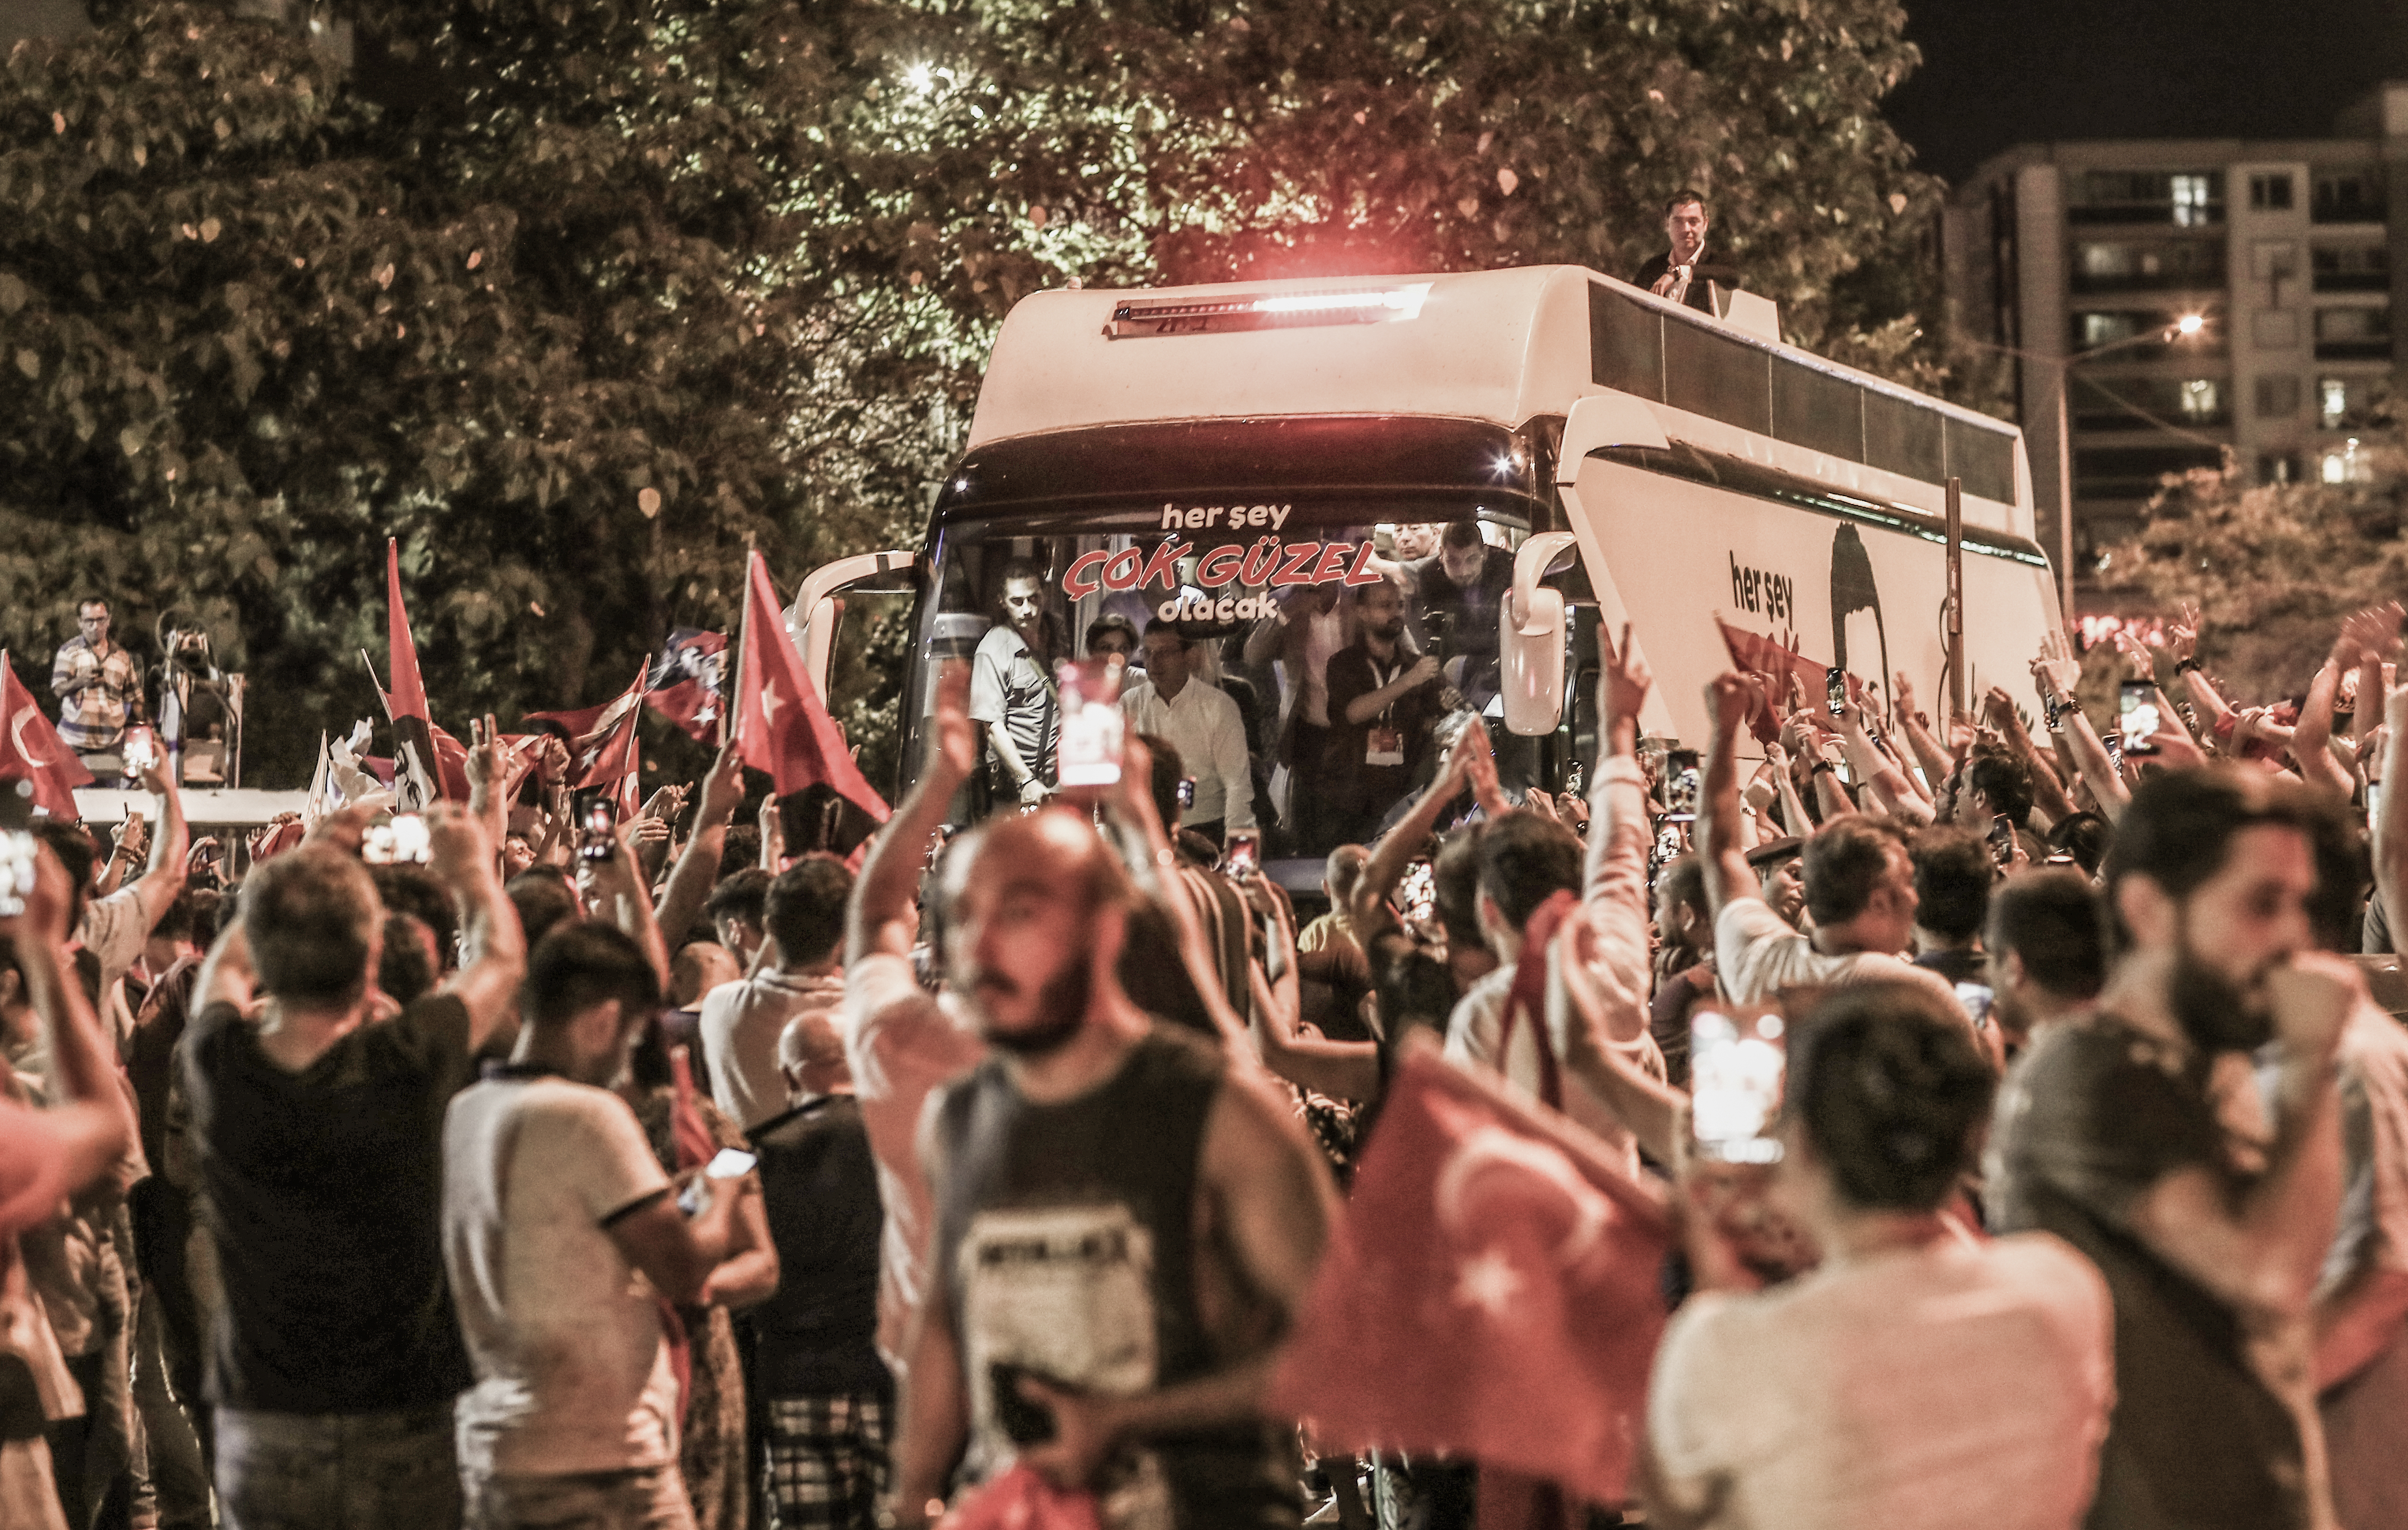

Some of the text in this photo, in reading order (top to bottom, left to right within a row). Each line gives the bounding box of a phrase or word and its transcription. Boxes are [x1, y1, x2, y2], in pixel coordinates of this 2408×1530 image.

[1162, 503, 1292, 531] her şey
[1062, 536, 1384, 601] ÇOK GÜZEL
[1729, 549, 1792, 631] her şey
[1158, 591, 1278, 623] olacak
